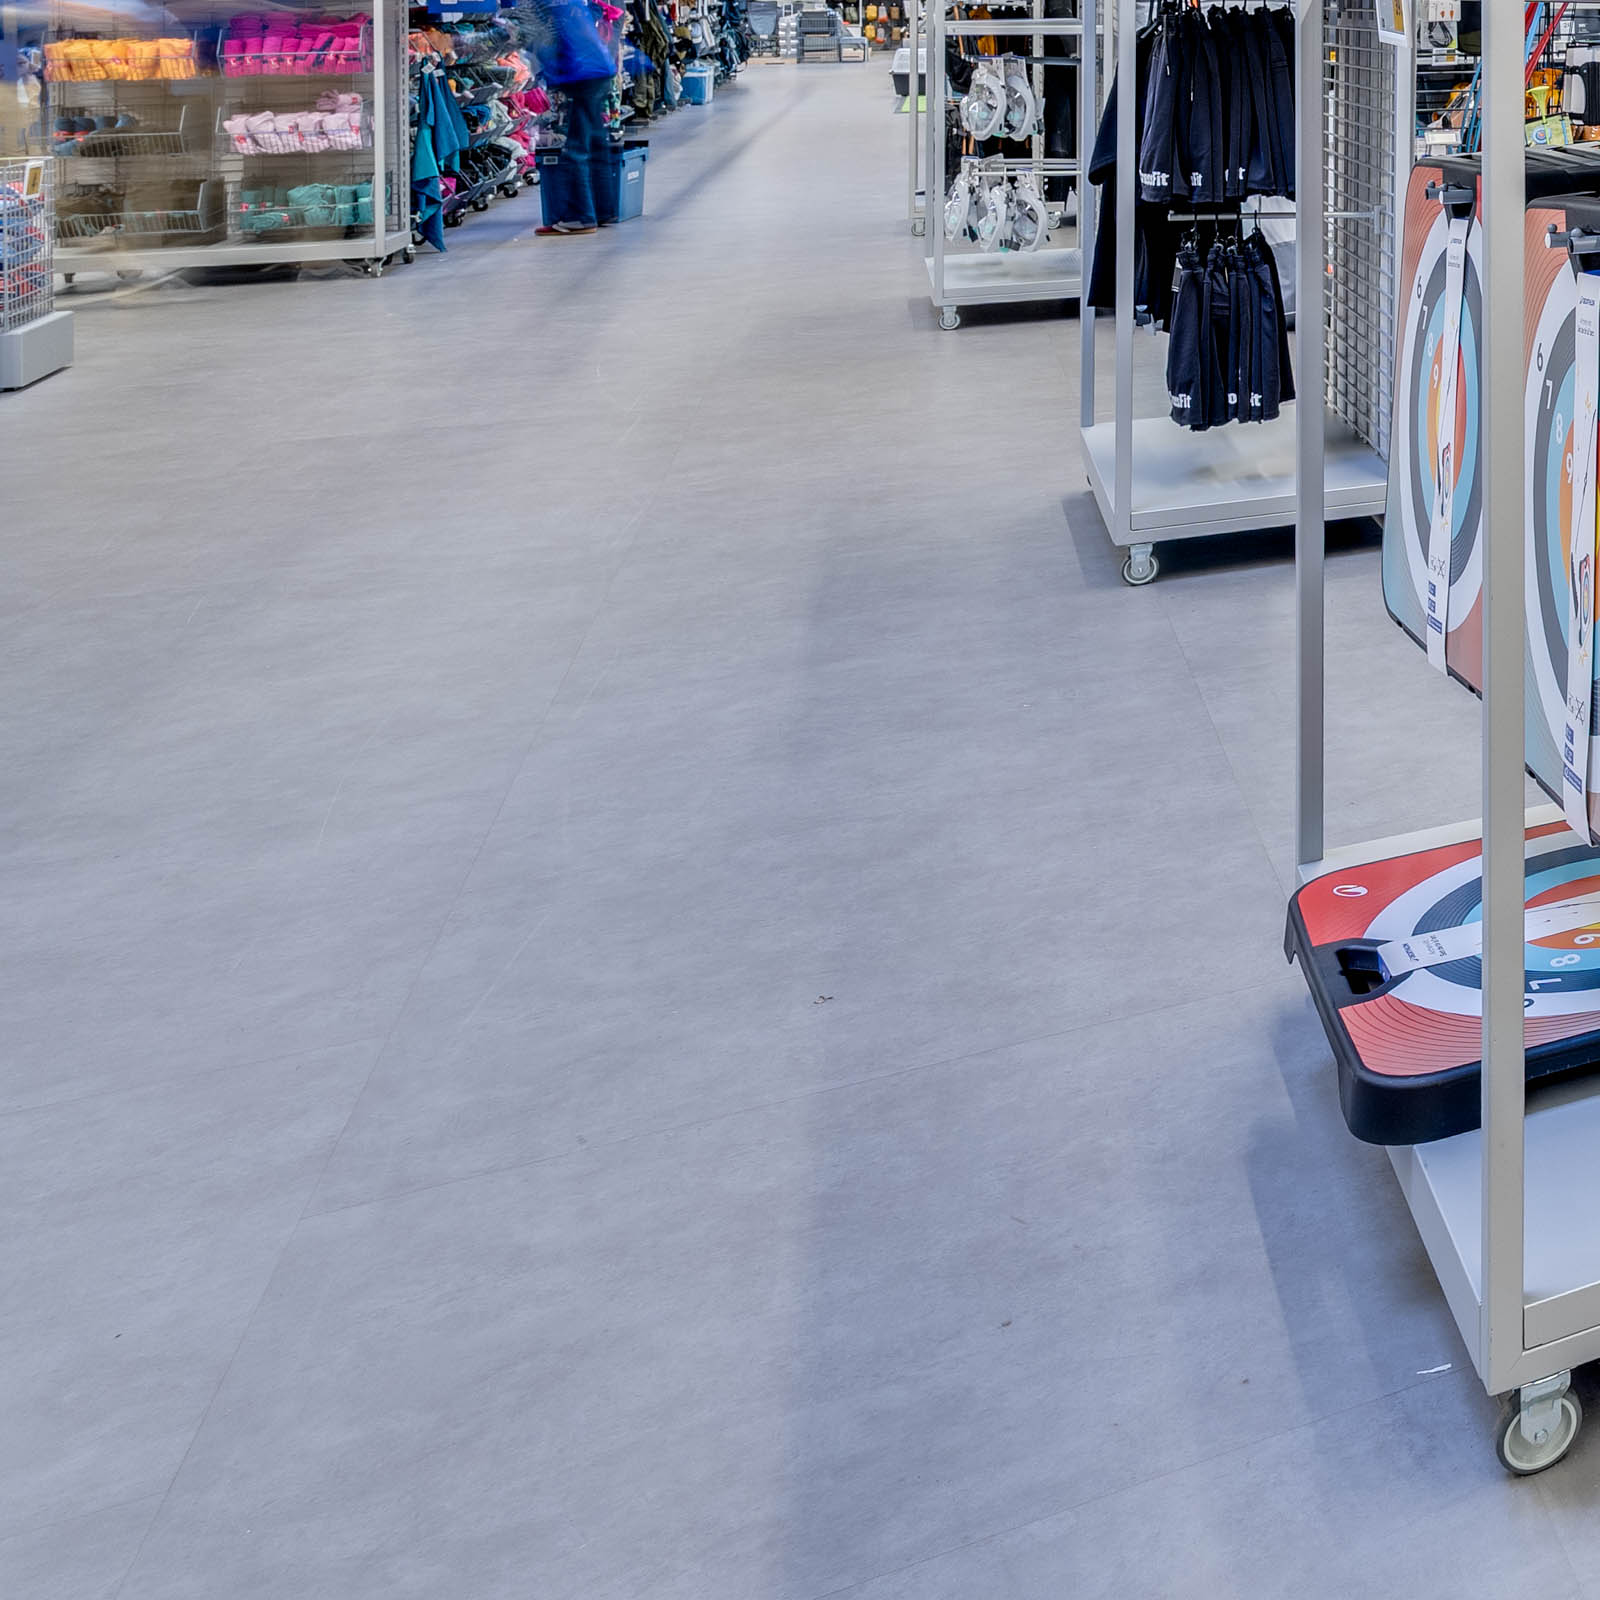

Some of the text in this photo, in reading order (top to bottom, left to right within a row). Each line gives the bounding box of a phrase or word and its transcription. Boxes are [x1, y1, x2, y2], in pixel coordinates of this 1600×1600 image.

[1536, 342, 1544, 371] 6
[1545, 380, 1553, 410] 7
[1556, 413, 1564, 443] 8
[1565, 451, 1573, 483] 9
